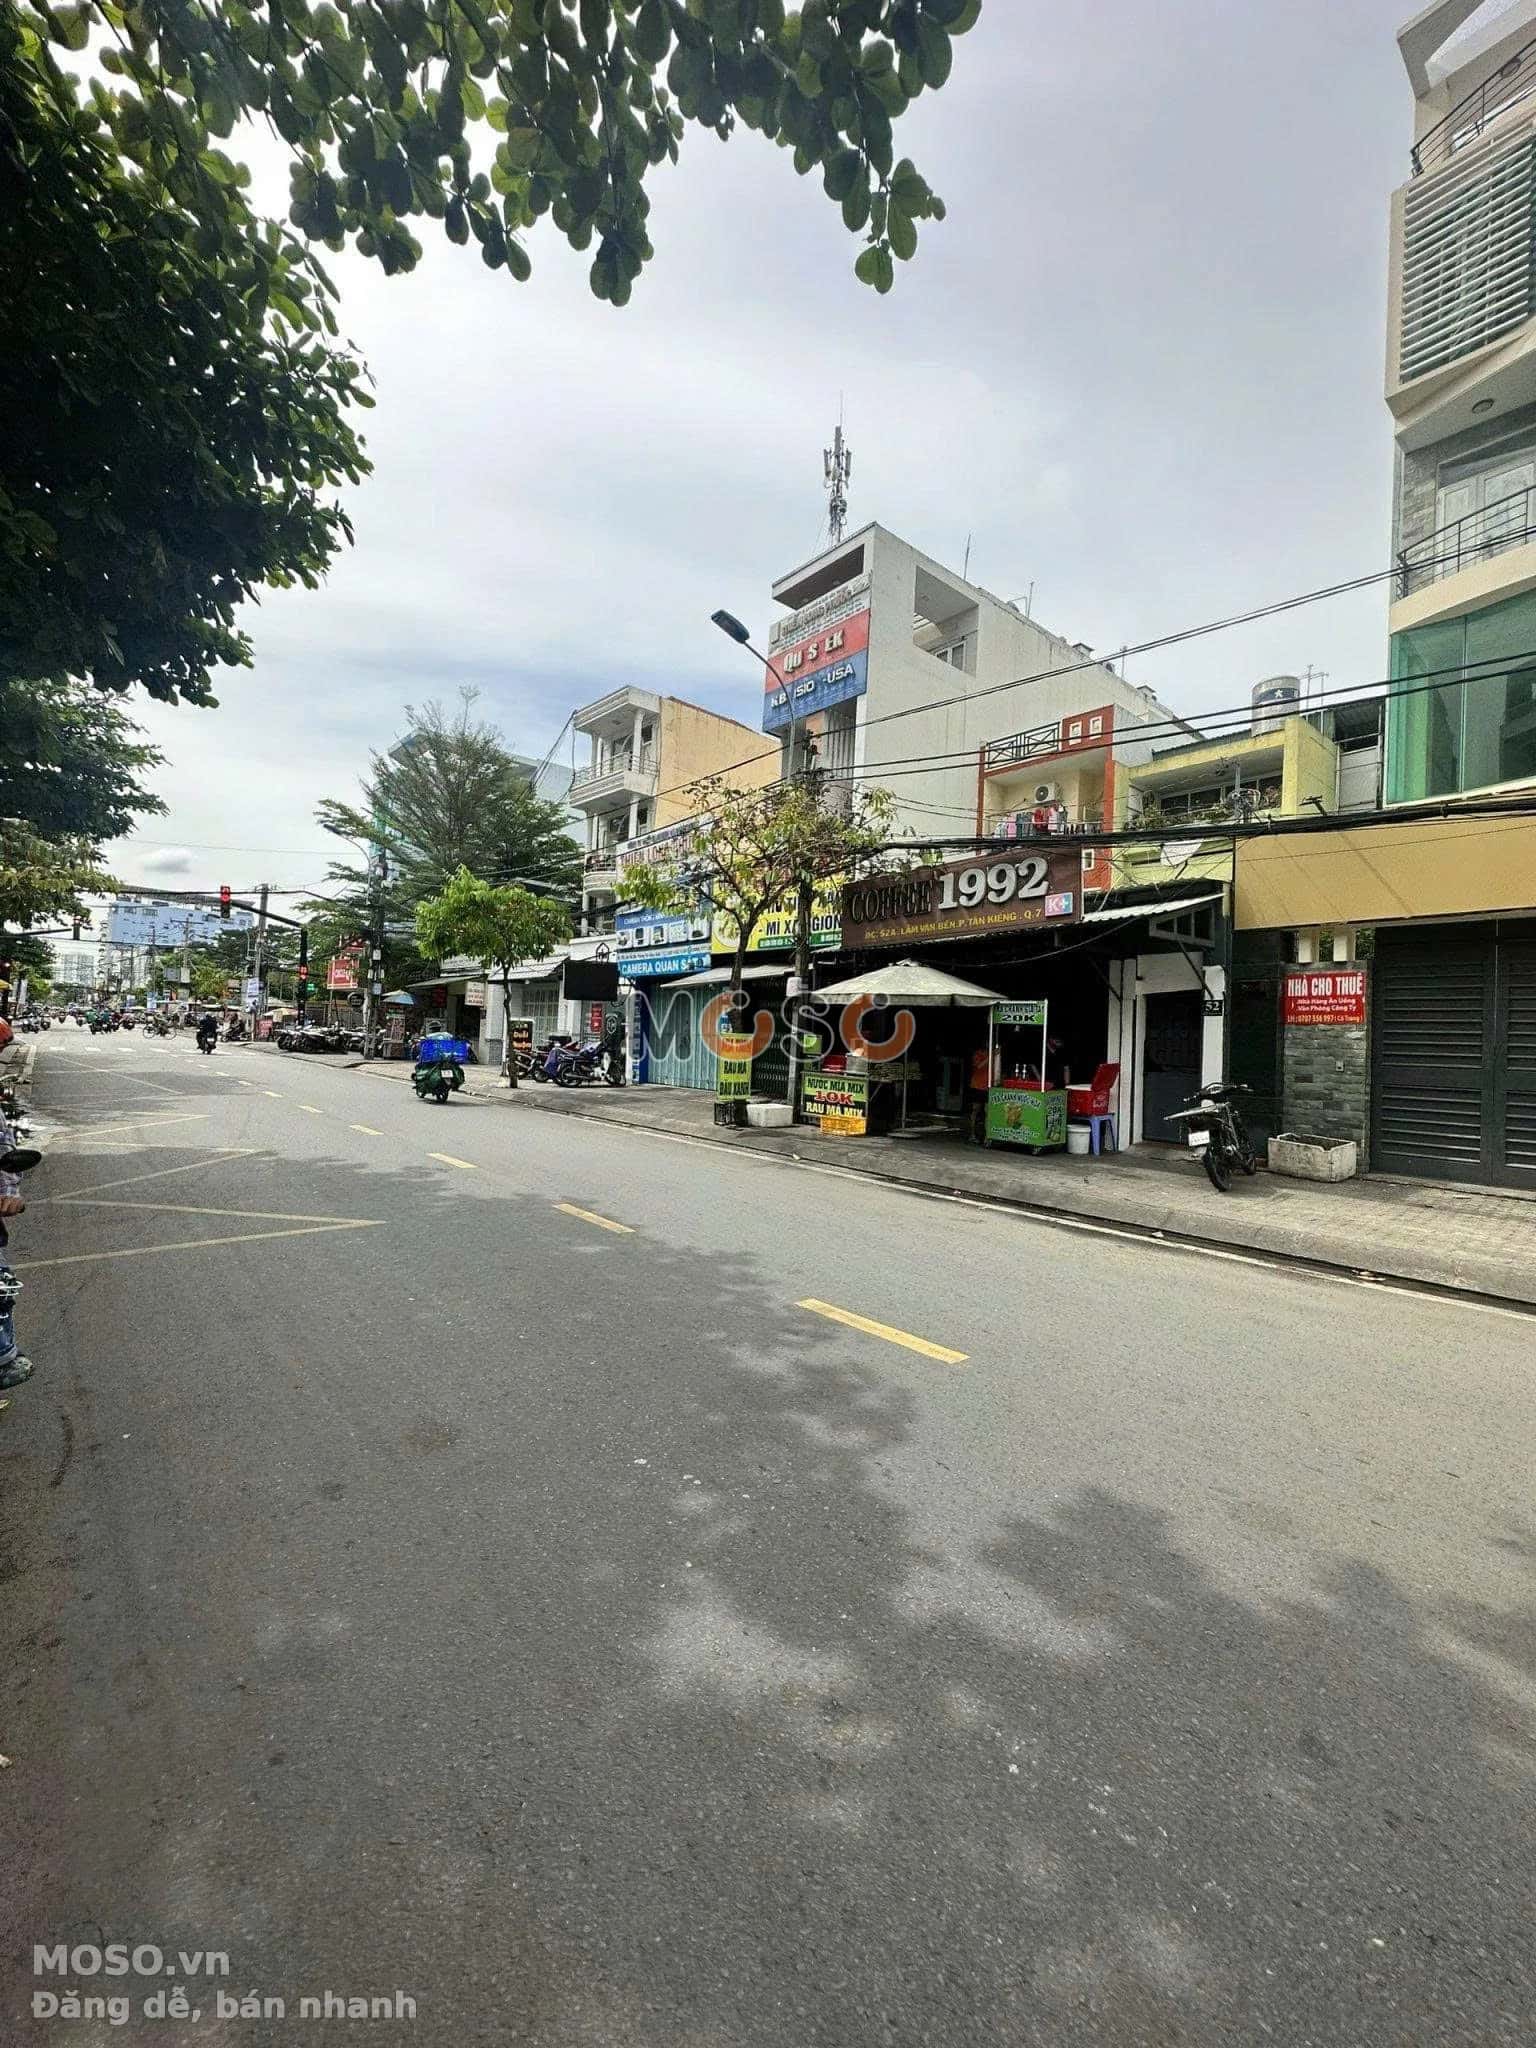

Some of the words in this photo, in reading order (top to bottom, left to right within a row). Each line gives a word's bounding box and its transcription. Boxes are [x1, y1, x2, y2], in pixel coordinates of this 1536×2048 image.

[851, 881, 932, 923] COFFEE
[938, 856, 1050, 910] 1992
[621, 961, 654, 975] CAMERA
[654, 959, 680, 973] QUAN
[1288, 975, 1308, 997] NHÀ
[1311, 977, 1333, 997] CHO
[1335, 972, 1363, 996] THUÊ
[1206, 1001, 1220, 1011] 52
[1002, 1014, 1036, 1022] 20K
[847, 1082, 865, 1095] MIX
[814, 1090, 855, 1106] 10K
[805, 1102, 825, 1114] RAU
